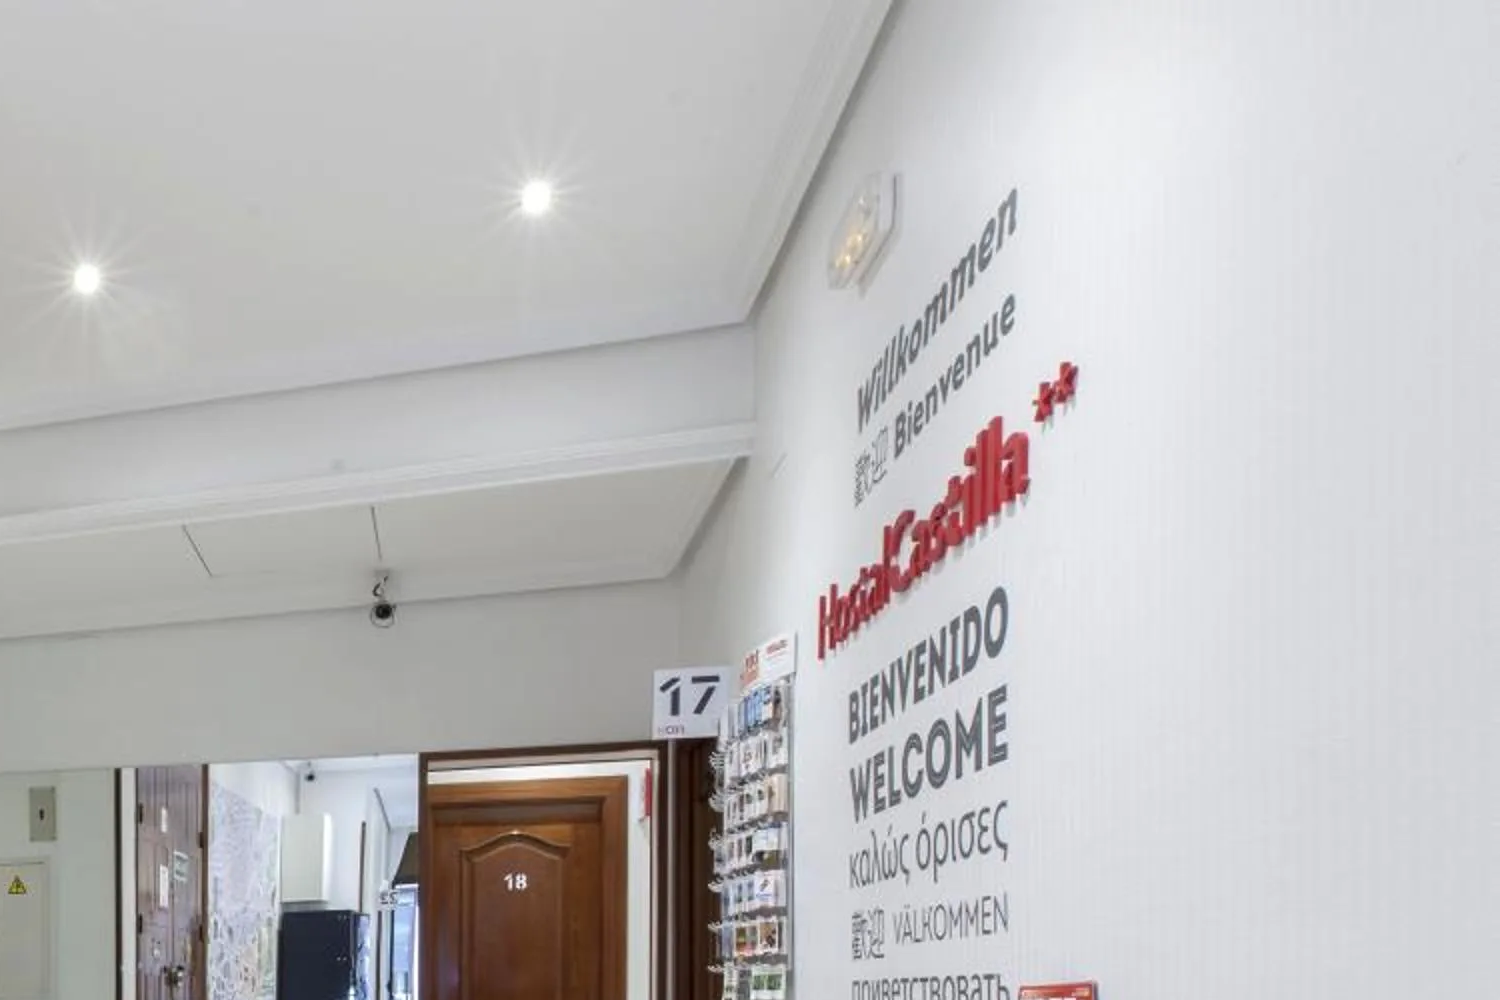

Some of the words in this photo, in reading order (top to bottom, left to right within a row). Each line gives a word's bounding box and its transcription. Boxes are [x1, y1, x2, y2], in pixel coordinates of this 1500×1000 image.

[857, 188, 1018, 433] Willkommen
[894, 293, 1016, 460] Bienvenue
[660, 675, 720, 716] 17
[849, 586, 1009, 744] BIENVENIDO
[850, 684, 1008, 823] WELCOME
[503, 873, 528, 891] 18
[893, 893, 1008, 945] VÄLKOMMEN
